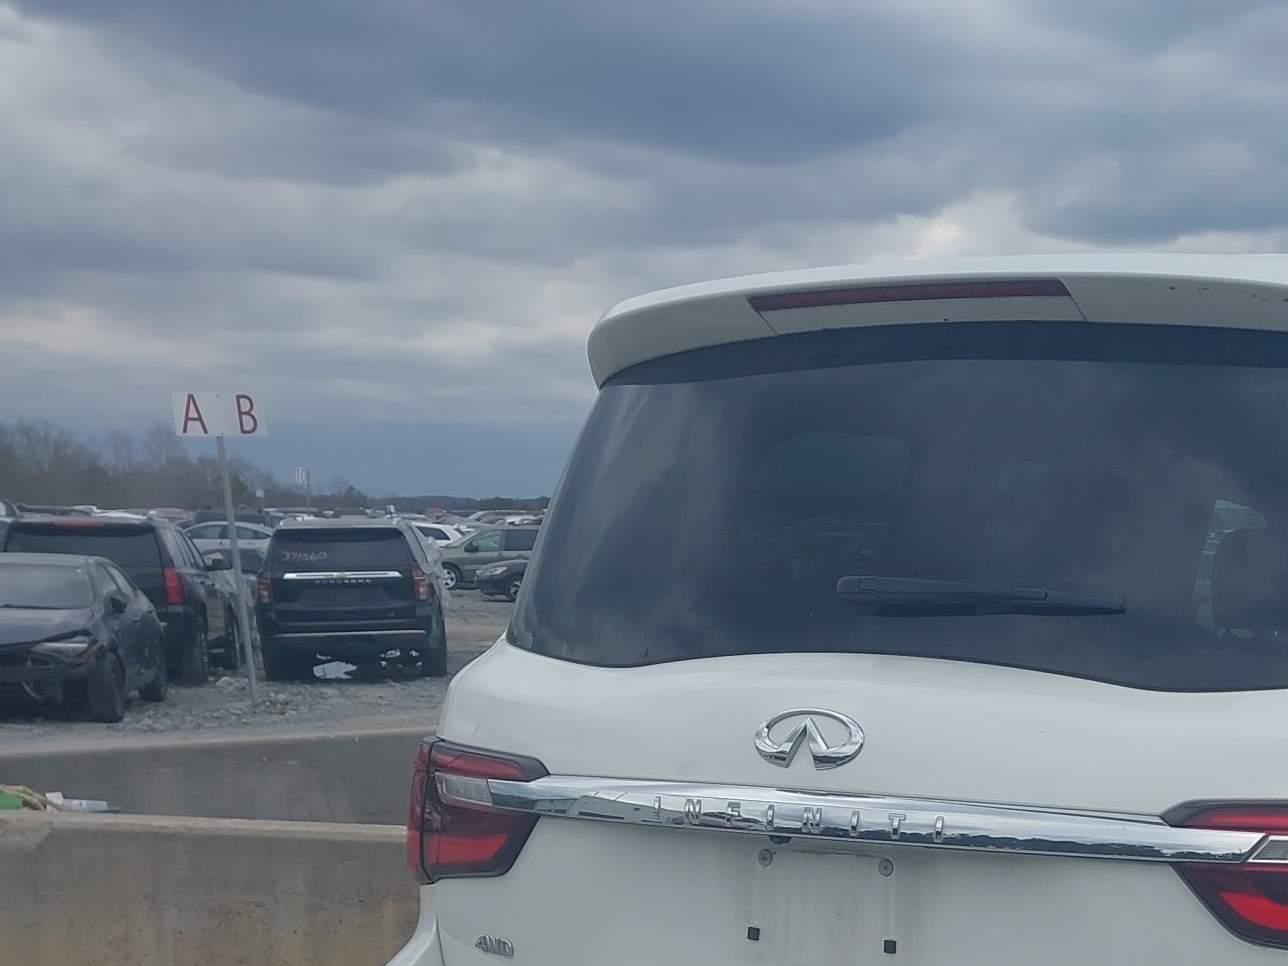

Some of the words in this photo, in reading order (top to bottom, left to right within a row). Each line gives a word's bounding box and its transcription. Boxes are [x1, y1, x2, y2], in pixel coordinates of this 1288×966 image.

[183, 393, 208, 434] A
[235, 394, 258, 434] B
[652, 795, 945, 844] INFINITI
